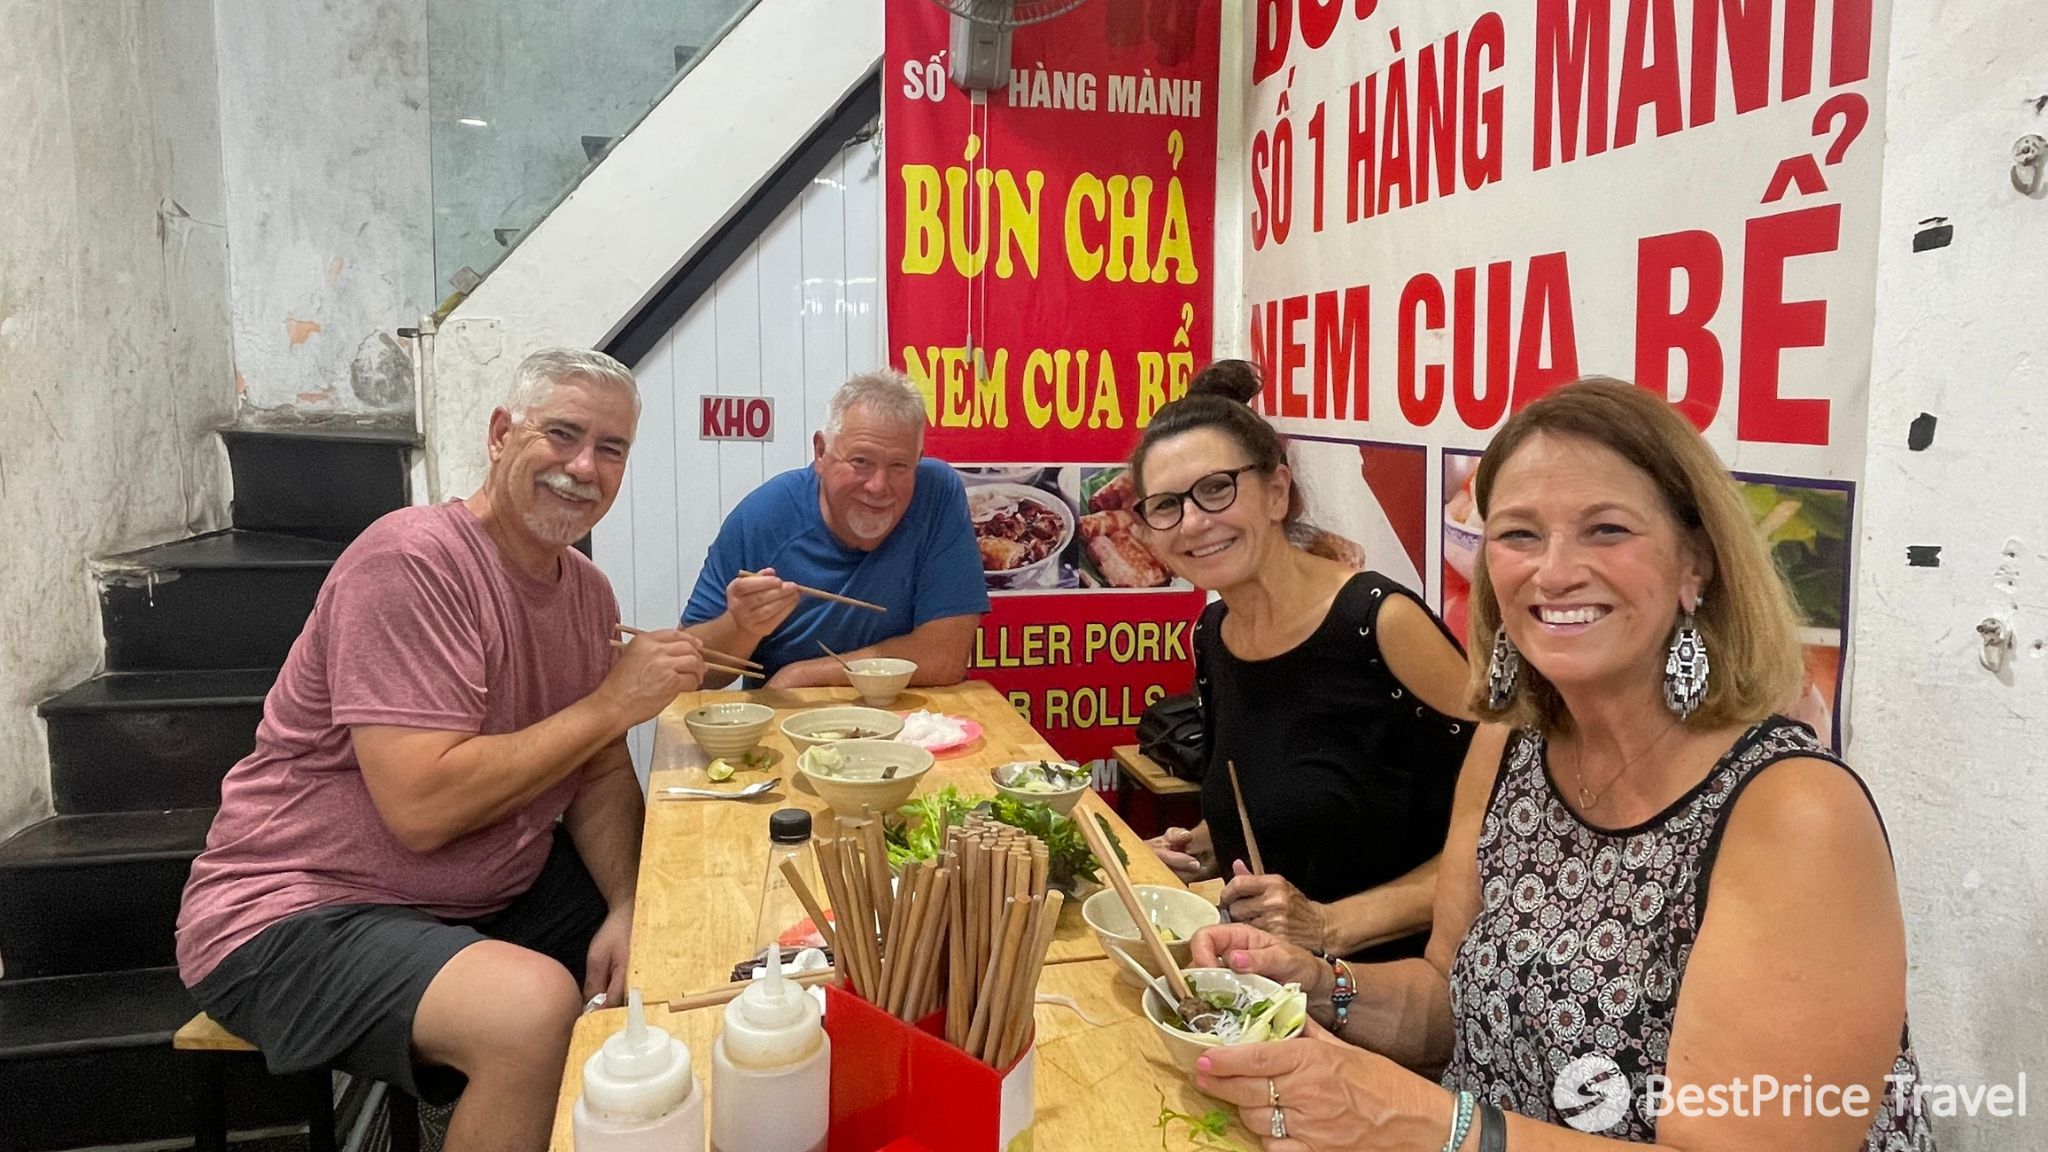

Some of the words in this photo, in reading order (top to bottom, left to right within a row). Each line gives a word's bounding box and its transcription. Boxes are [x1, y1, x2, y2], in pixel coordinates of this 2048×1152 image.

[903, 50, 947, 102] SỐ
[1008, 62, 1096, 111] HÀNG
[1108, 69, 1201, 118] MÀNH
[1251, 66, 1295, 251] SỐ
[1308, 102, 1325, 233] 1
[1345, 12, 1505, 224] HÀNG
[901, 133, 1044, 280] BÚN
[1064, 129, 1198, 284] CHẢ
[1250, 284, 1370, 422] NEM
[1398, 251, 1580, 430] CUA
[1634, 92, 1870, 446] BỂ
[703, 398, 770, 437] KHO
[903, 345, 1009, 428] NEM
[1022, 347, 1123, 429] CUA
[967, 624, 1071, 668] LLER
[1086, 621, 1187, 663] PORK
